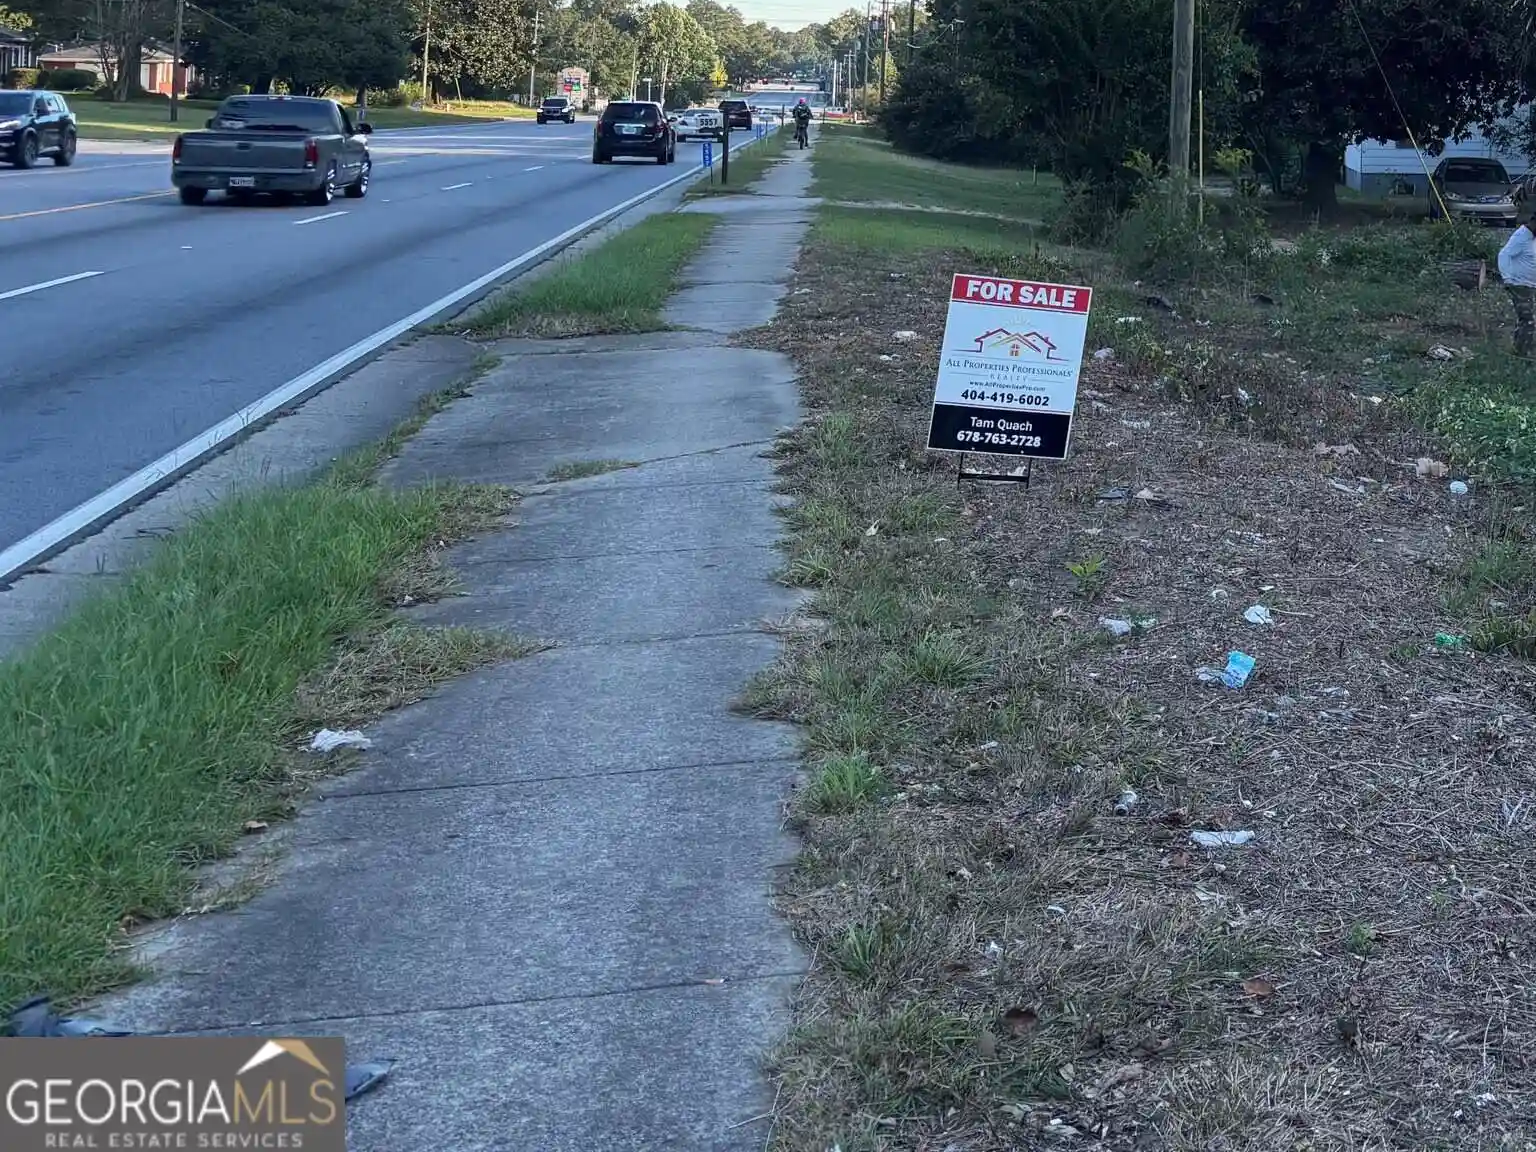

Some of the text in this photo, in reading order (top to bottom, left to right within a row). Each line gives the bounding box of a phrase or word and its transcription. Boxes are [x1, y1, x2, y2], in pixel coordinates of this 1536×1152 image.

[699, 118, 718, 127] 5557
[966, 279, 1077, 308] FOR SALE
[946, 358, 1072, 377] ALL PROPERTIES PROFESSIONALS
[961, 389, 1050, 406] 404-419-6002
[970, 416, 1033, 432] Tam Quach
[956, 430, 1041, 448] 678-763-2728
